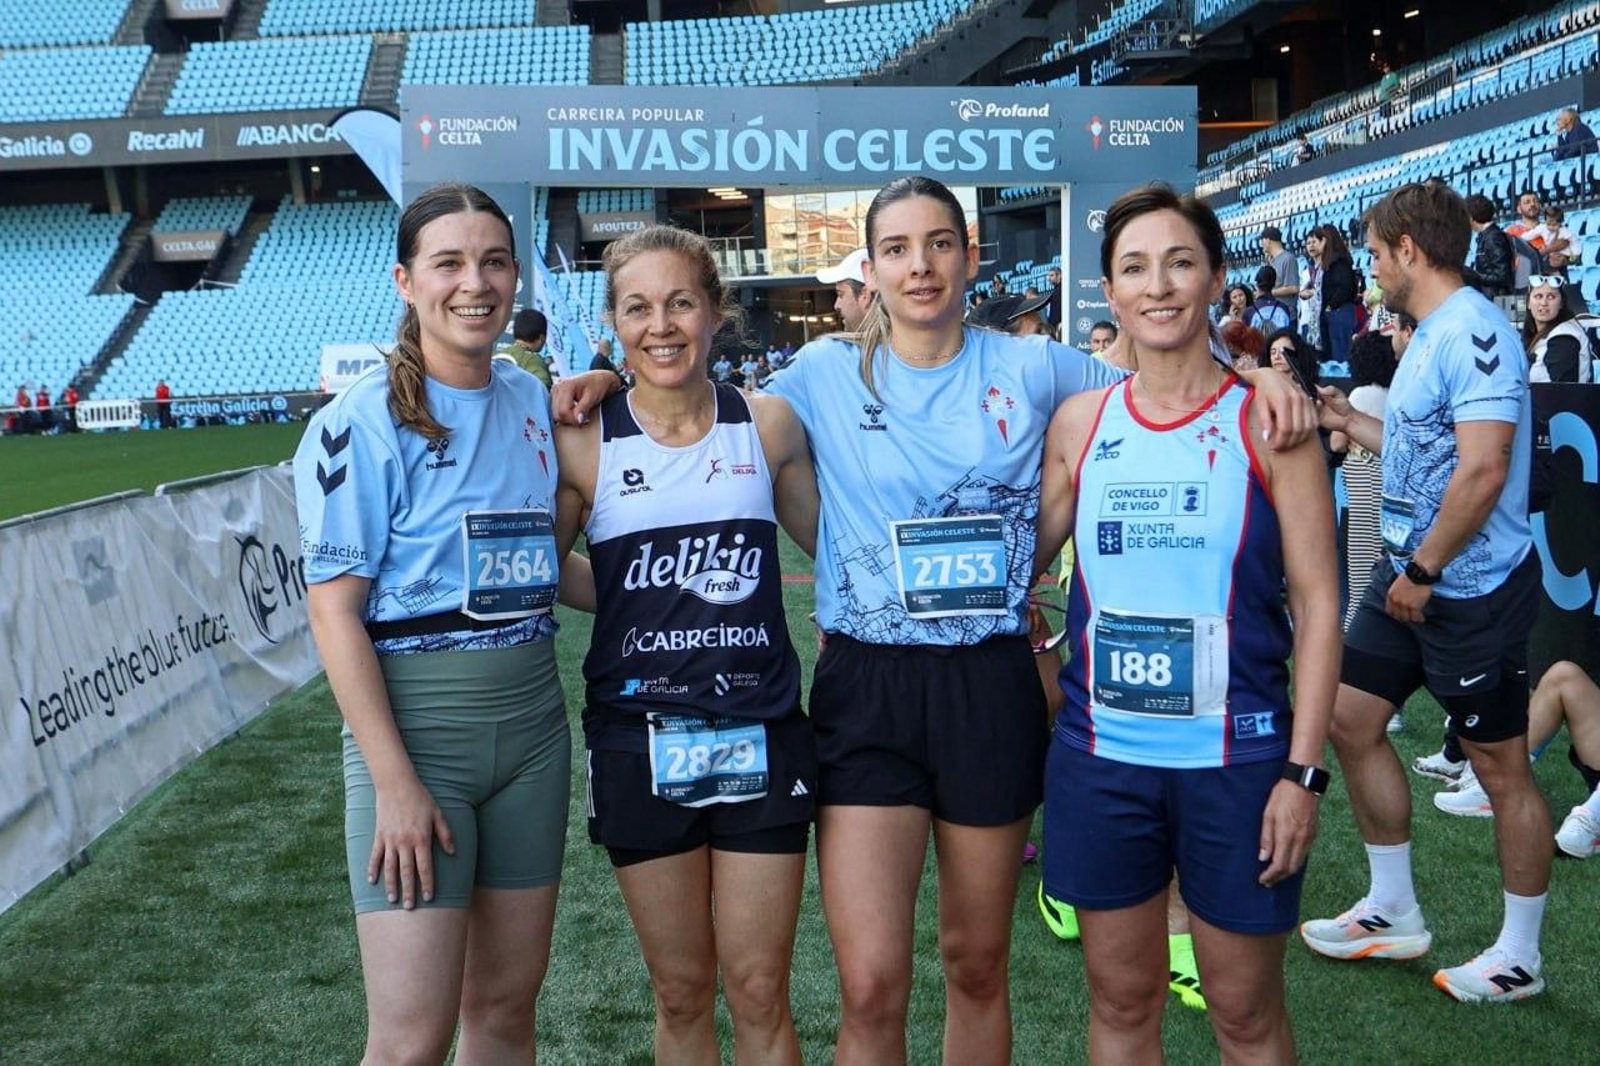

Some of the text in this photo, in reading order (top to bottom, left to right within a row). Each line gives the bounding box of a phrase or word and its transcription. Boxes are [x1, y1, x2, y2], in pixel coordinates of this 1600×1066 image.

[547, 107, 705, 122] CARREIRA POPULAR
[985, 103, 1050, 118] Profand
[439, 116, 518, 132] FUNDACIÓN
[1109, 117, 1185, 133] FUNDACIÓN
[127, 128, 205, 152] Recalvi
[439, 131, 482, 146] CELTA
[548, 115, 1056, 172] INVASIÓN CELESTE
[1109, 133, 1151, 147] CELTA
[859, 422, 888, 431] hummel
[425, 457, 458, 471] hummel
[1108, 487, 1168, 500] CONCELLO
[1111, 501, 1160, 512] DE VIGO
[944, 527, 976, 536] CELESTE
[1127, 523, 1175, 535] XUNTA
[1127, 535, 1206, 549] DE GALICIA
[476, 549, 552, 587] 2564
[624, 533, 763, 591] delikia
[911, 552, 997, 588] 2753
[704, 577, 741, 594] fresh
[637, 622, 770, 652] CABREIROÁ
[1109, 650, 1173, 687] 188
[20, 667, 115, 747] Leading
[106, 646, 146, 696] the
[650, 685, 689, 694] GALICIA
[665, 739, 756, 781] 2829
